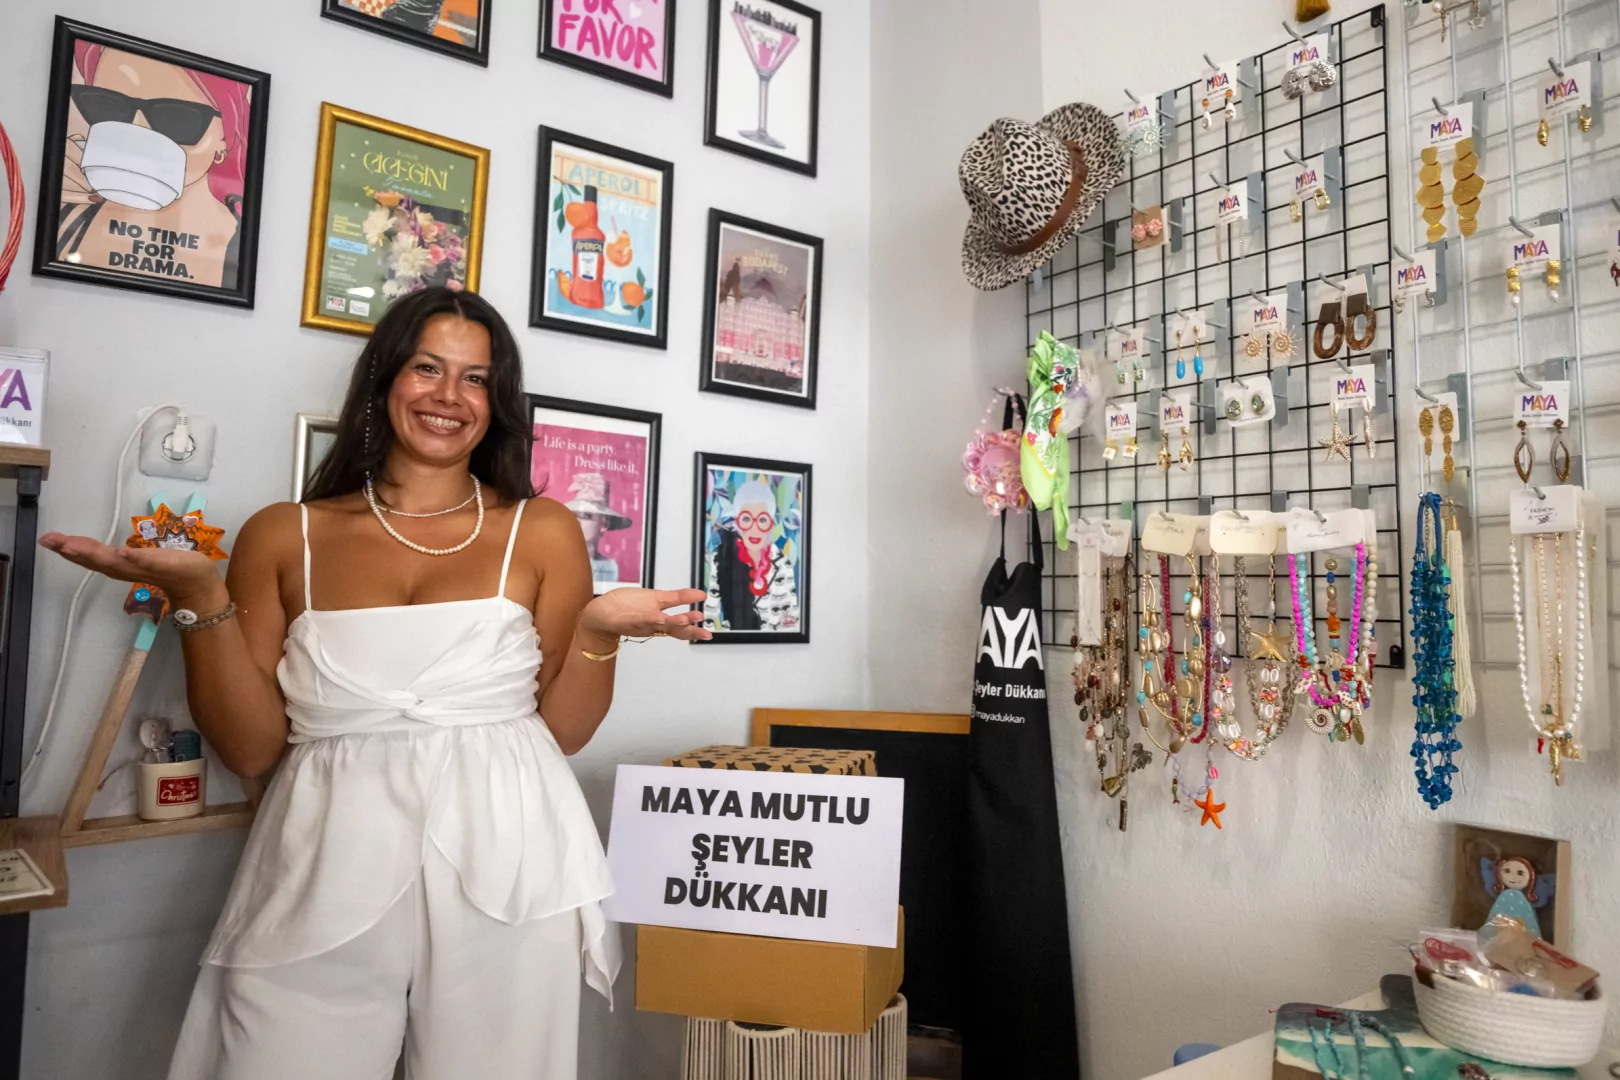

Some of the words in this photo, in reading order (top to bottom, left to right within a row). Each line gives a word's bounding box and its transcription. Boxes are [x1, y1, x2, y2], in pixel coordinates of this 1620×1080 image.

[558, 13, 658, 71] FAVOR
[1293, 46, 1320, 66] MAYA
[1206, 72, 1230, 92] MAYA
[1545, 78, 1579, 105] MAYA
[1430, 117, 1463, 139] MAYA
[568, 163, 642, 196] APEROL
[1295, 169, 1318, 190] MAYA
[1218, 194, 1241, 214] MAYA
[108, 218, 143, 238] NO
[147, 226, 200, 250] TIME
[132, 239, 175, 260] FOR
[1513, 239, 1550, 261] MAYA
[108, 251, 195, 280] DRAMA.
[1397, 264, 1427, 285] MAYA
[1254, 306, 1279, 323] MAYA
[1337, 377, 1367, 395] MAYA
[1163, 405, 1184, 421] MAYA
[1522, 394, 1558, 412] MAYA
[1110, 413, 1131, 428] MAYA
[543, 435, 566, 450] Life
[567, 439, 576, 451] is
[577, 443, 585, 451] a
[574, 455, 606, 469] Dress
[607, 458, 627, 473] like
[641, 785, 744, 818] MAYA
[750, 791, 870, 826] MUTLU
[691, 833, 814, 871] ŞEYLER
[664, 871, 828, 919] DÜKKANI
